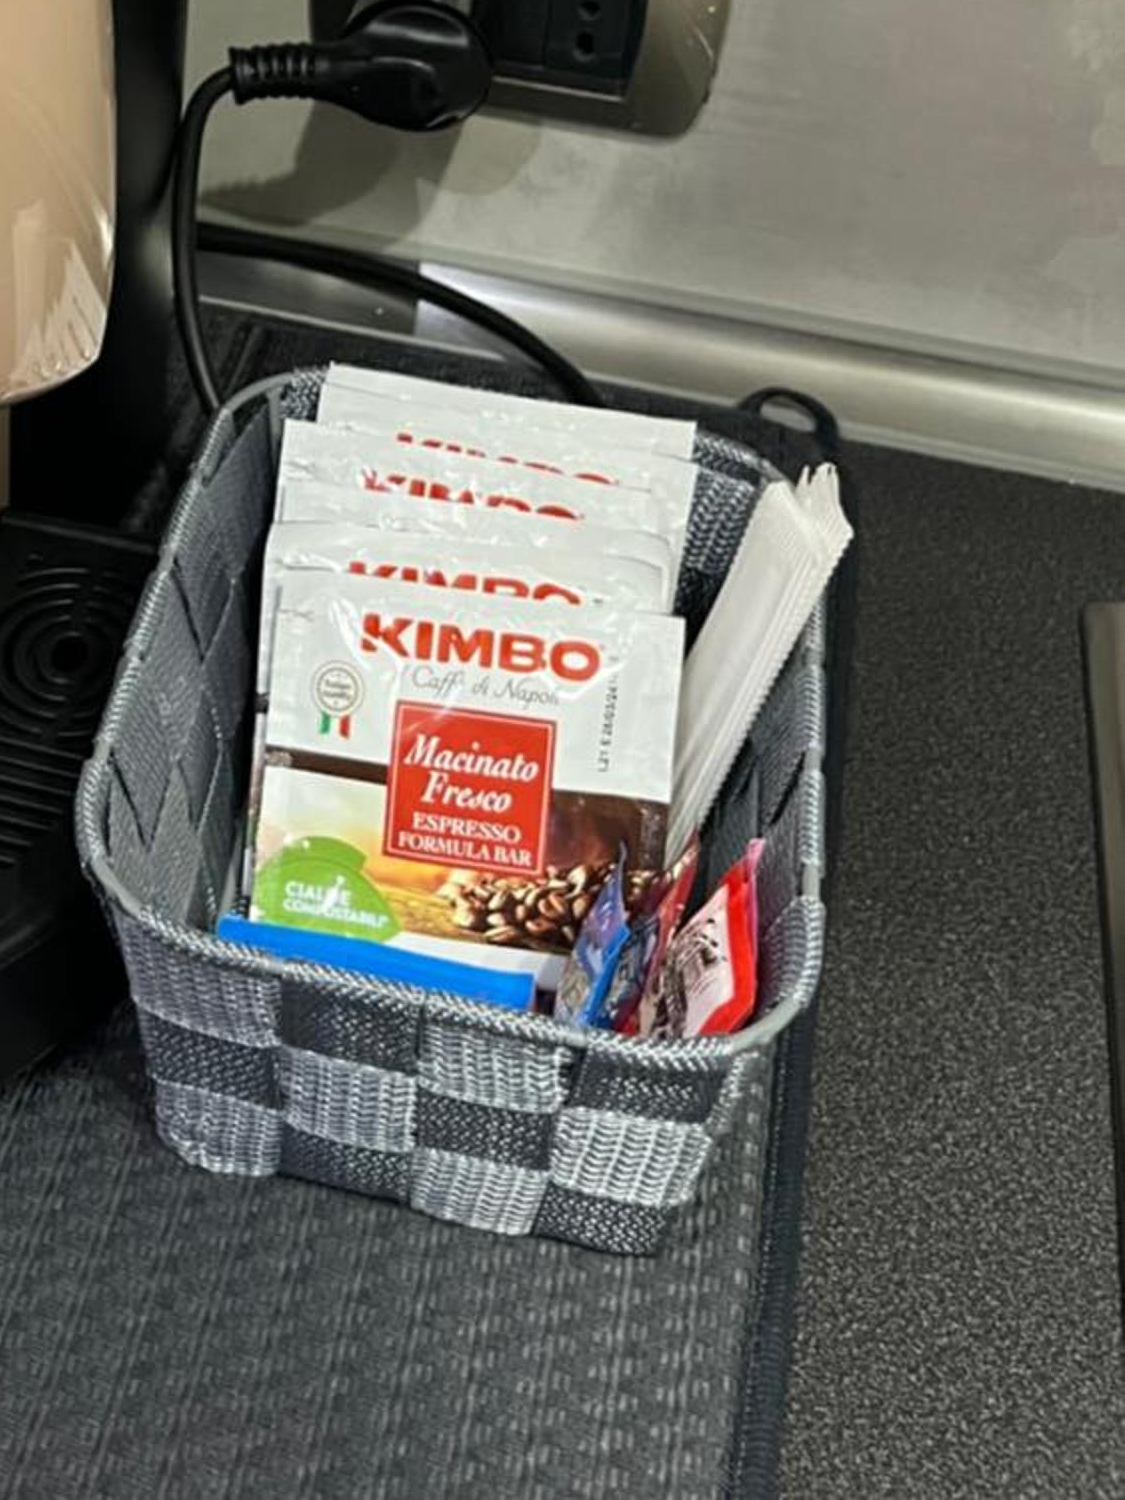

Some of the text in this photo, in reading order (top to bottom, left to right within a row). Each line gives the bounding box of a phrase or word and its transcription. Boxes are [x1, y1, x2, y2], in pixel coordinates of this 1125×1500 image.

[361, 612, 601, 682] KIMBO
[412, 664, 466, 699] Caff
[403, 733, 540, 783] Macinato
[421, 769, 513, 813] Fresco
[412, 811, 522, 844] ESPRESSO
[398, 831, 532, 867] FORMULA BAR
[284, 880, 352, 908] CIALE
